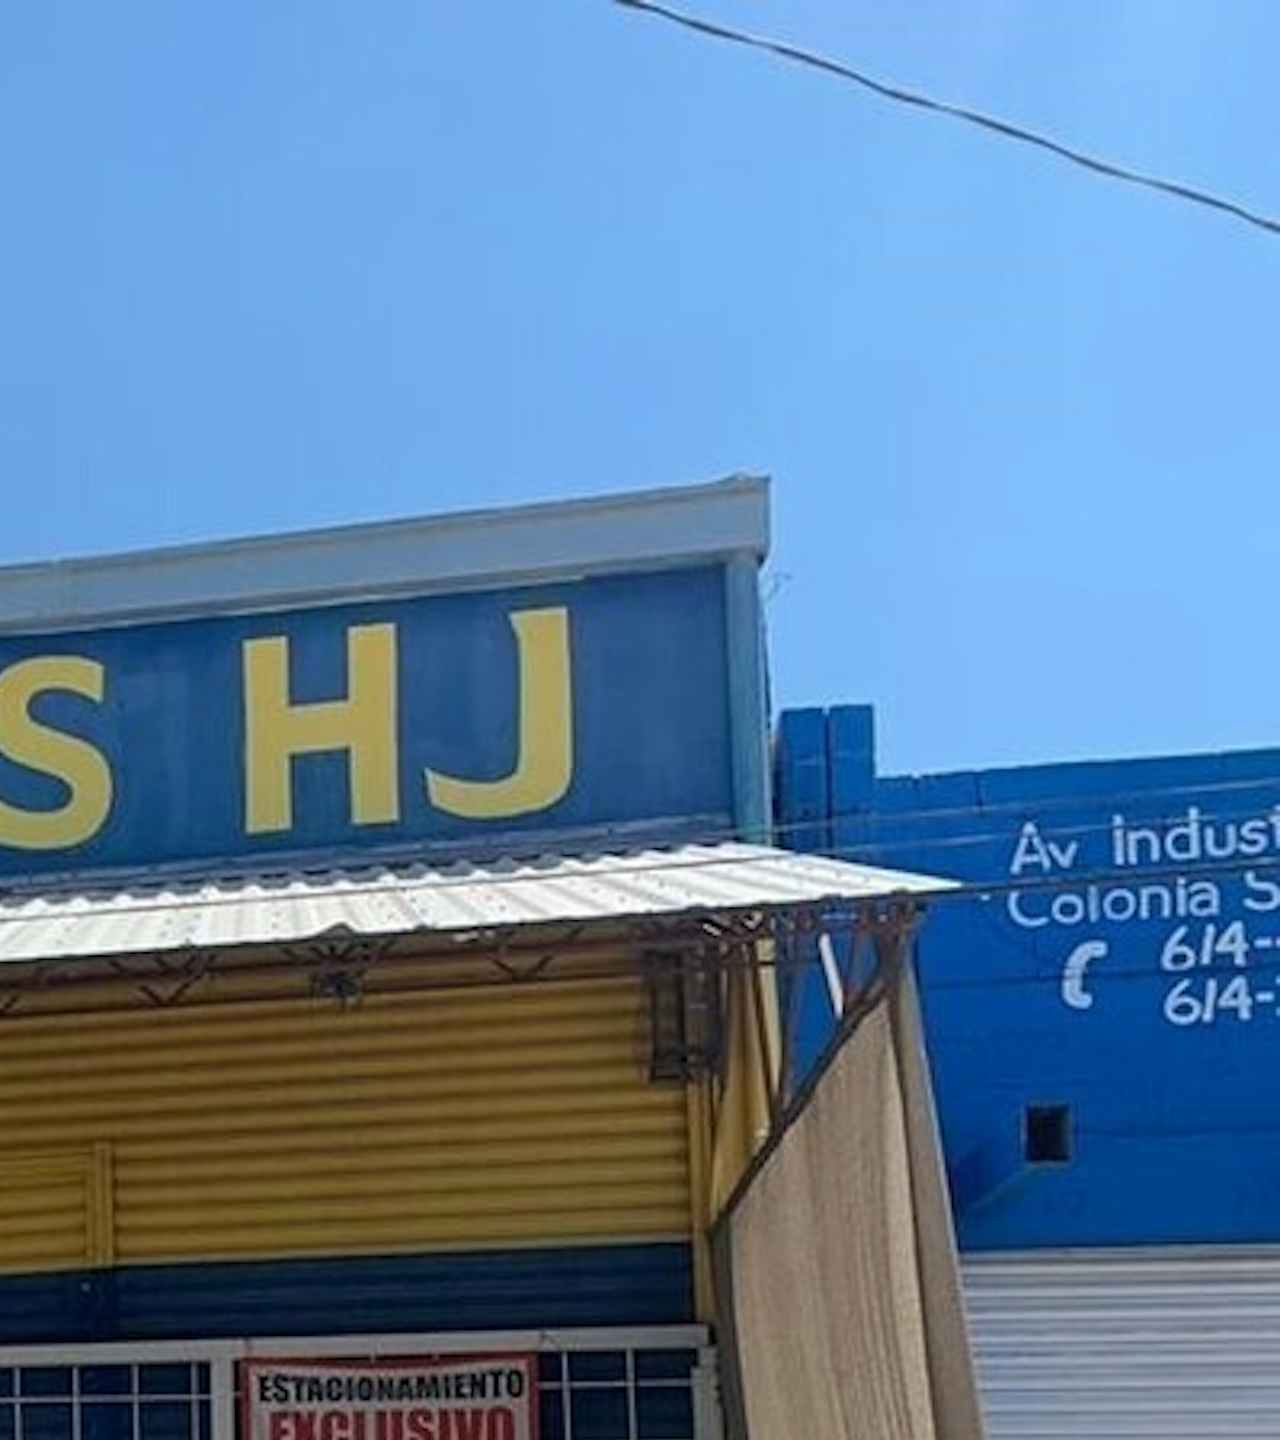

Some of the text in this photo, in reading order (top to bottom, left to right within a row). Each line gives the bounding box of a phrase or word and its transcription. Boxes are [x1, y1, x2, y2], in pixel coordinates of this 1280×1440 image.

[1008, 820, 1078, 875] Av
[1006, 876, 1221, 928] Colonia
[1161, 920, 1280, 972] 614-
[1163, 974, 1280, 1025] 614-
[259, 1370, 523, 1402] ESTACIONAMIENTO
